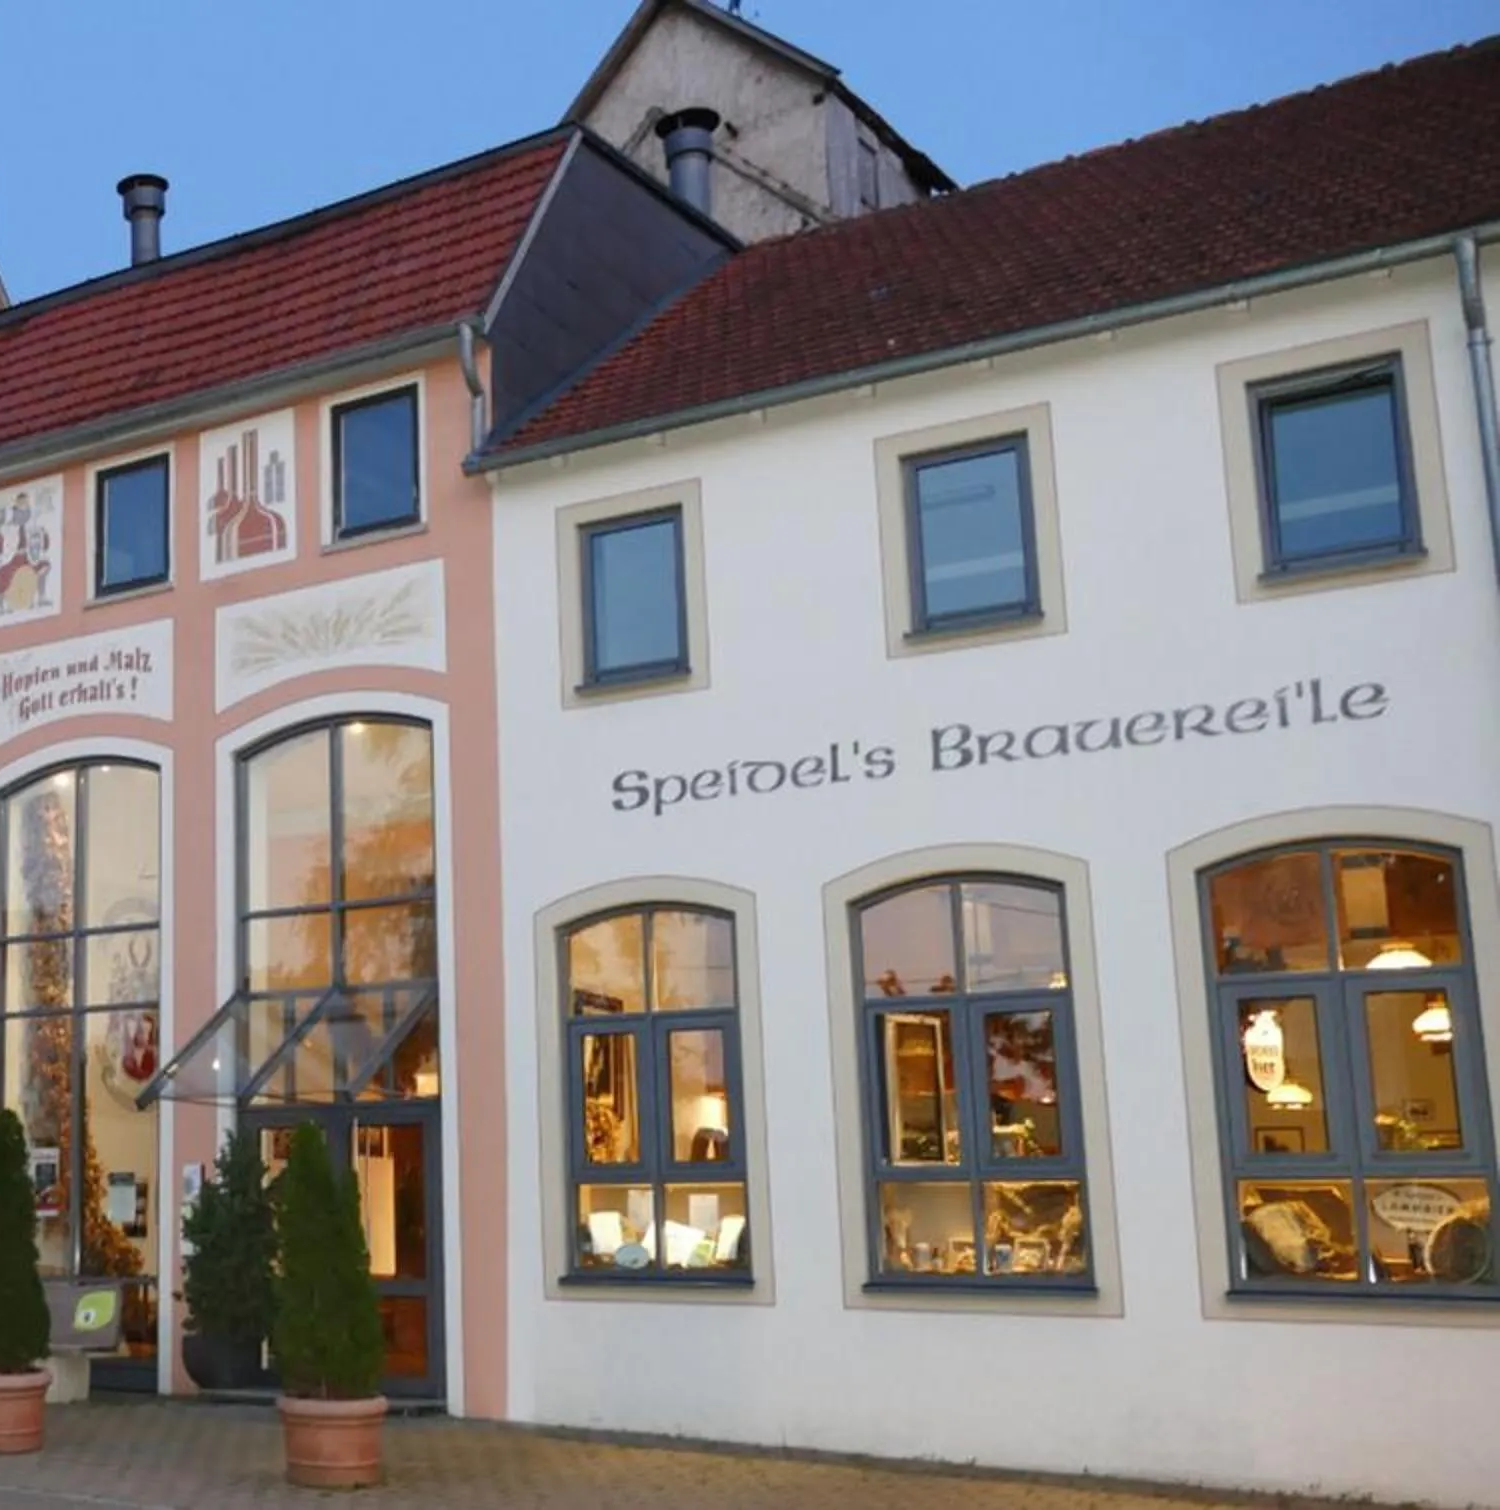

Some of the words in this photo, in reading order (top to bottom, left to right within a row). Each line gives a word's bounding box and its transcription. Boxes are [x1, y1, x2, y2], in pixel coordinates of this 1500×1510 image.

[2, 666, 60, 701] Hopfen
[66, 655, 98, 677] und
[103, 647, 152, 673] Malz
[19, 690, 53, 720] Gott
